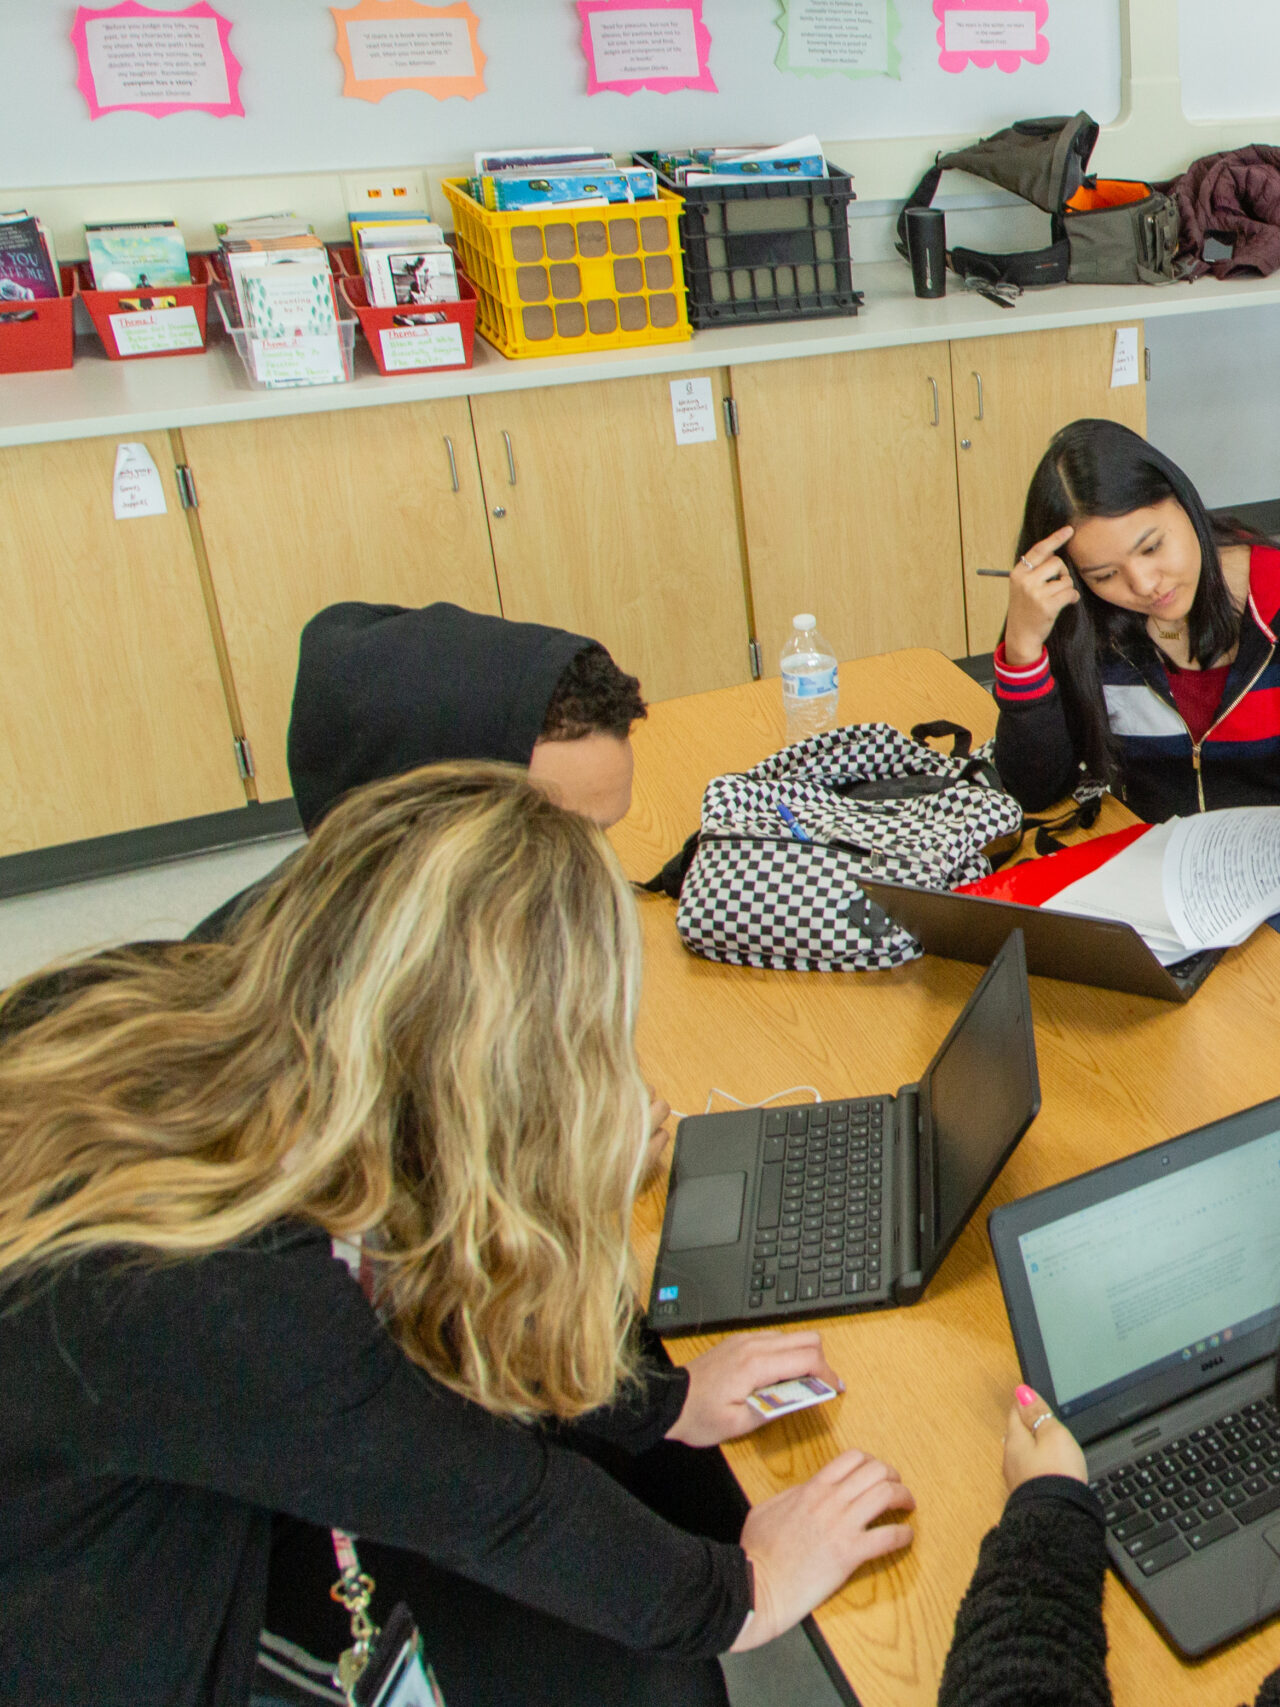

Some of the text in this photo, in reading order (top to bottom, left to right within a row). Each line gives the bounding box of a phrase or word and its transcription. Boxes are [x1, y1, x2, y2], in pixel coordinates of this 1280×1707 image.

[7, 252, 39, 267] YOU
[25, 267, 46, 281] ME
[1201, 1356, 1224, 1371] DELL
